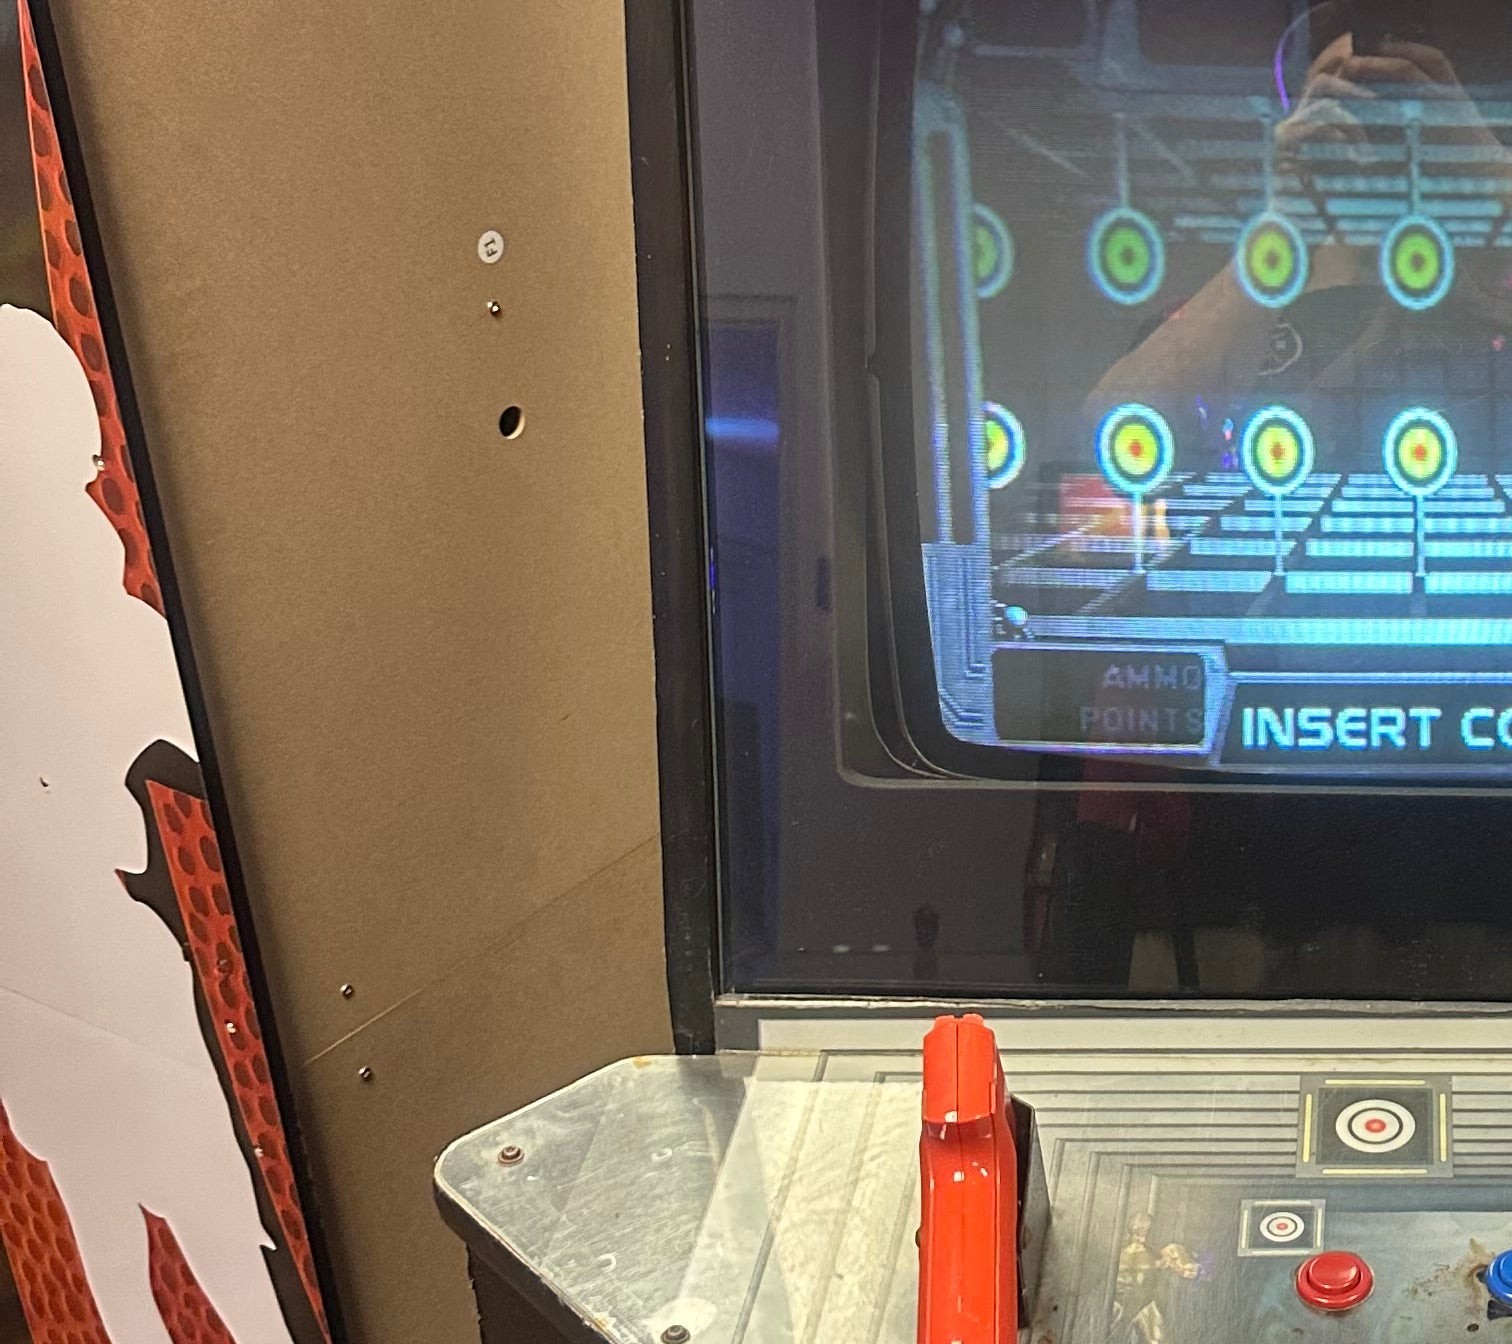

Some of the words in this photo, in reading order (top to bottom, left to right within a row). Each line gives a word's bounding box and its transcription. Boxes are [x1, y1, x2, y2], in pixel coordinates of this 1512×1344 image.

[1102, 664, 1201, 690] AMMO
[1079, 706, 1202, 733] POINTS
[1242, 706, 1443, 751] INSERT
